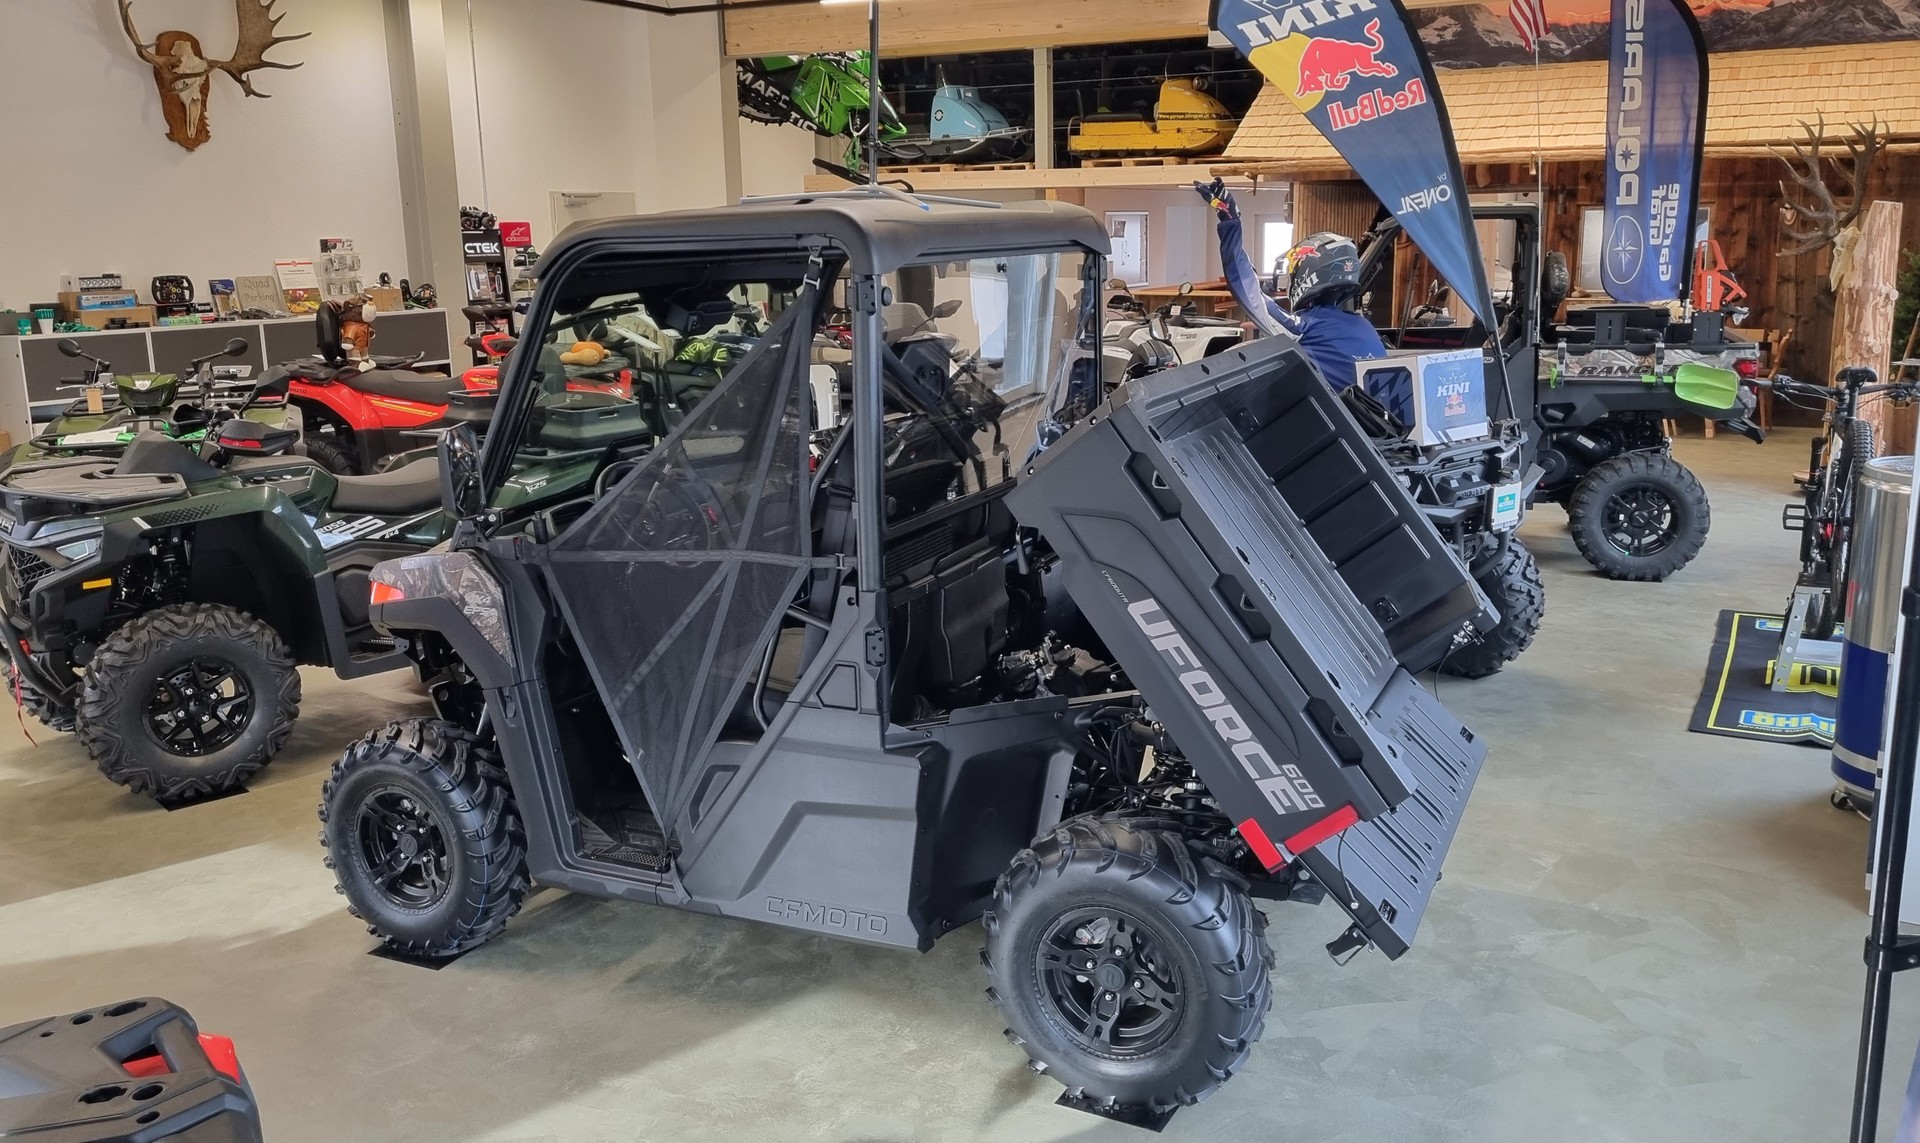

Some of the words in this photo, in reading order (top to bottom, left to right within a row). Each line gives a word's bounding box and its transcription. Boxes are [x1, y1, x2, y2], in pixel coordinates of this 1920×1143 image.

[464, 242, 500, 254] CTEK
[1436, 381, 1470, 398] KINI
[1127, 598, 1309, 815] UFORCE
[1281, 764, 1327, 808] 600
[766, 895, 888, 936] CFMOTO
